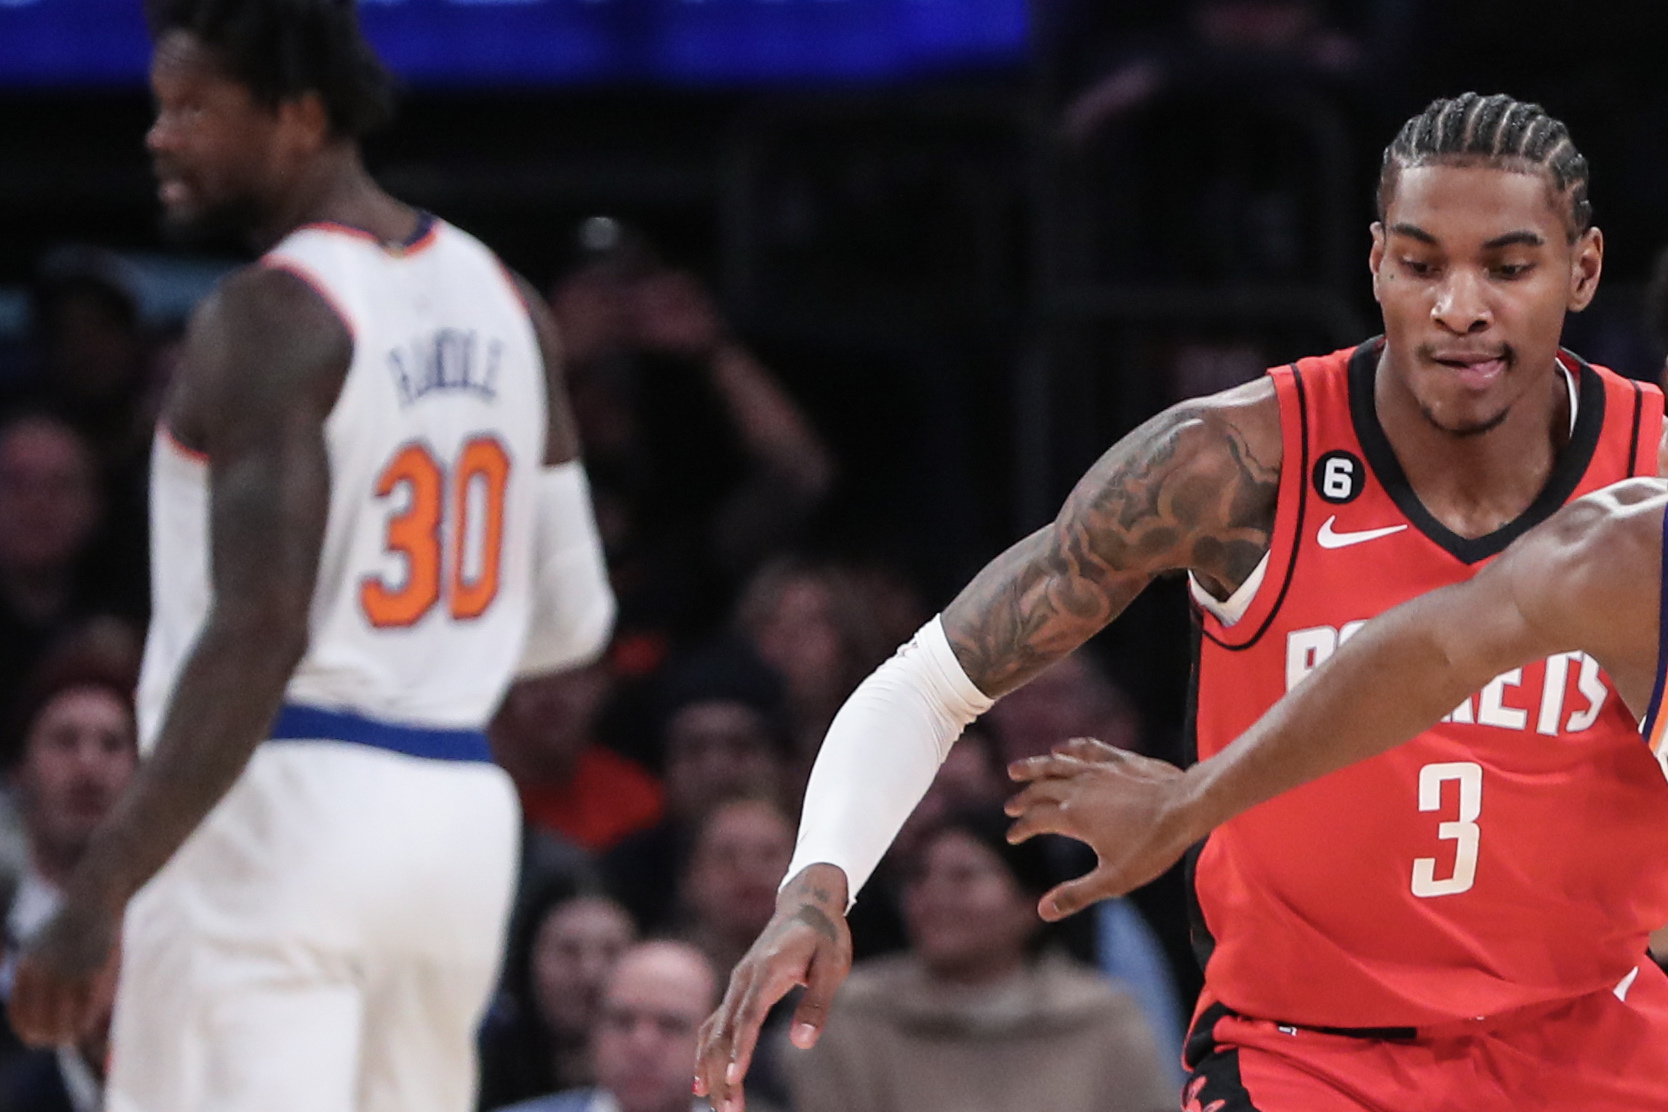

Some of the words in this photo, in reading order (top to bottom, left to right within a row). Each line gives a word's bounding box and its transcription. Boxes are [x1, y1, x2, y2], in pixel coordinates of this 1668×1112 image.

[357, 432, 513, 630] 30
[1323, 456, 1354, 499] 6
[1286, 619, 1609, 737] RETS
[1411, 761, 1483, 898] 3
